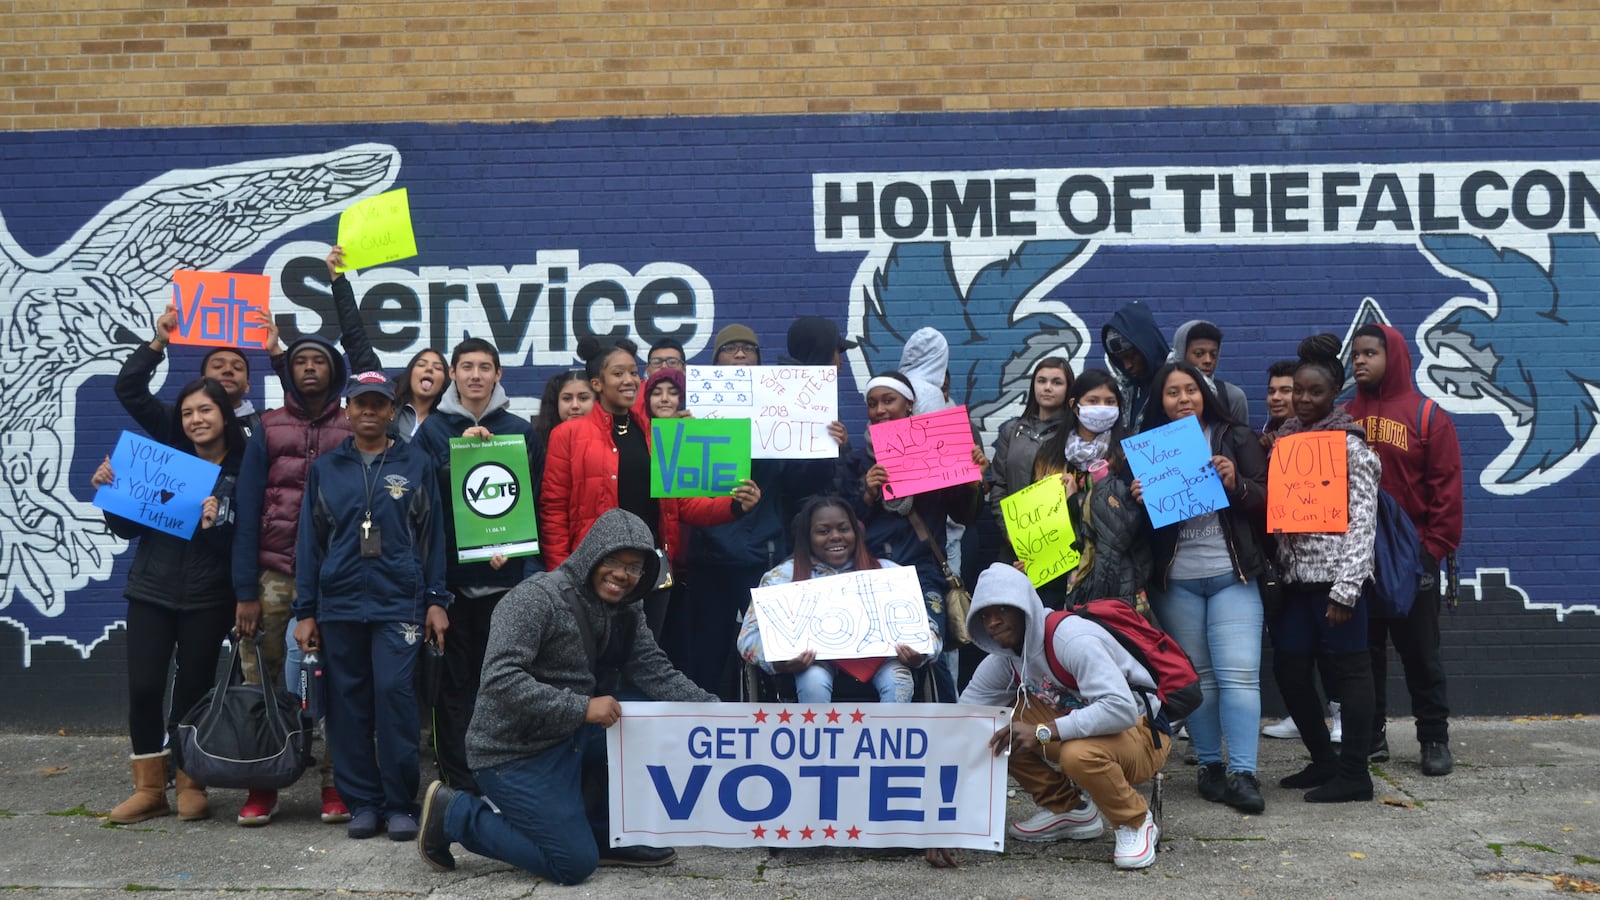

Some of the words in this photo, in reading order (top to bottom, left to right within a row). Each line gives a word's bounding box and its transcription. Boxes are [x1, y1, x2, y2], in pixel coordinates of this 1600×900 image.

[825, 178, 1037, 239] HOME
[1057, 174, 1155, 235] OF
[1166, 172, 1309, 233] THE
[1323, 169, 1600, 231] FALCON
[275, 256, 697, 352] Service
[760, 405, 789, 417] 2018
[494, 439, 524, 447] Superpower
[755, 420, 828, 452] VOTE
[1140, 446, 1182, 464] Voice
[467, 476, 518, 503] VOTE
[1149, 487, 1198, 513] VOTE
[1007, 500, 1044, 530] Your
[1179, 499, 1215, 521] NOW
[1016, 526, 1060, 555] Vote
[1179, 526, 1221, 540] NIVERSIT
[687, 726, 760, 760] GET
[771, 726, 844, 760] OUT
[853, 726, 928, 760] AND
[646, 763, 959, 822] VOTE!
